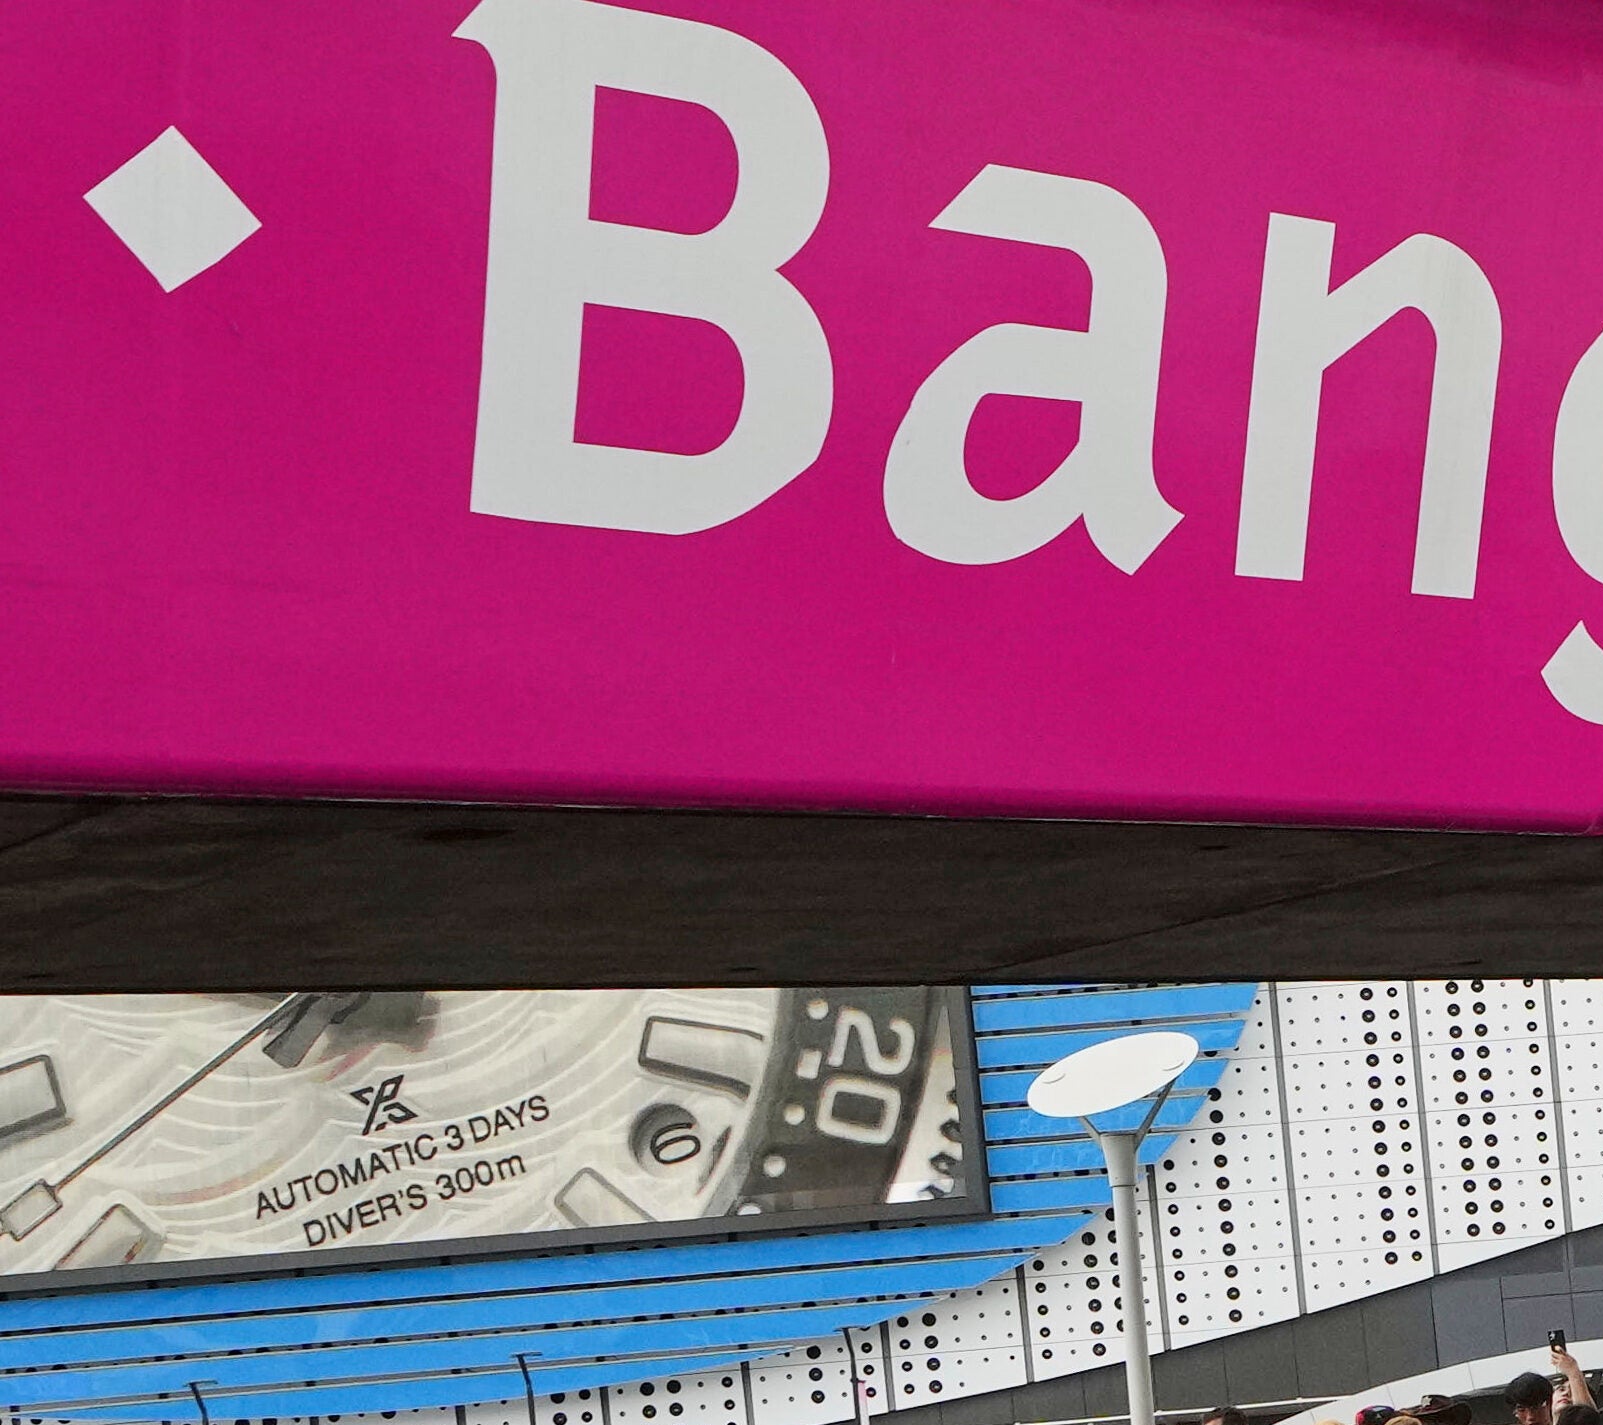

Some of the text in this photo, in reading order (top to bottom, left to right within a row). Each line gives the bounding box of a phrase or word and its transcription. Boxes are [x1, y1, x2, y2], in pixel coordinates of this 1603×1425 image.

[823, 1008, 915, 1146] 20
[256, 1095, 550, 1220] AUTOMATIC 3 DAYS
[650, 1122, 702, 1165] 6
[303, 1152, 527, 1247] DIVER'S 300m
